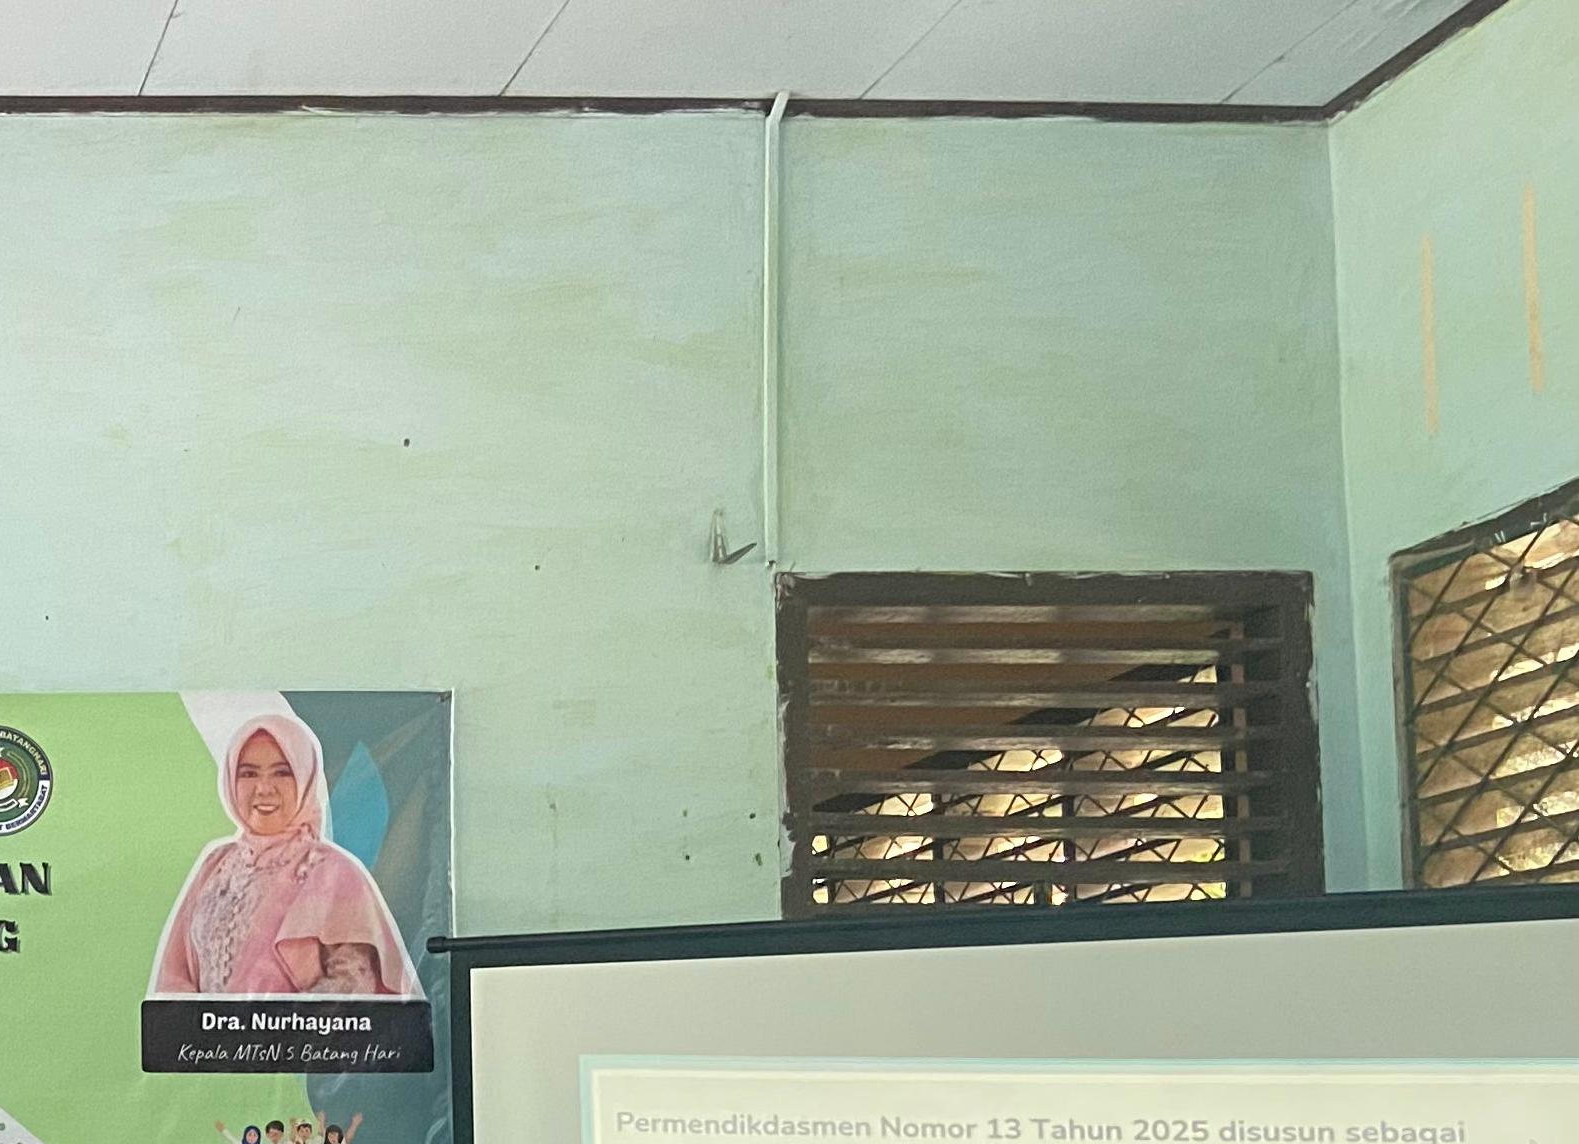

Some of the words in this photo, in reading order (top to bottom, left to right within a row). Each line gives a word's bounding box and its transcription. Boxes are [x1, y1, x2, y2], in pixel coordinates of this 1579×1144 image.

[201, 1012, 246, 1031] Dra.
[252, 1012, 372, 1035] Nurhayana
[177, 1043, 229, 1064] Kepala
[232, 1043, 281, 1061] MTsN
[300, 1044, 359, 1064] Batang
[364, 1044, 401, 1062] Hari
[617, 1112, 871, 1139] Permendikdasmen
[881, 1115, 978, 1140] Nomor
[987, 1117, 1022, 1140] 13
[1029, 1117, 1123, 1142] Tahun
[1132, 1119, 1209, 1143] 2025
[1218, 1119, 1336, 1144] disusun
